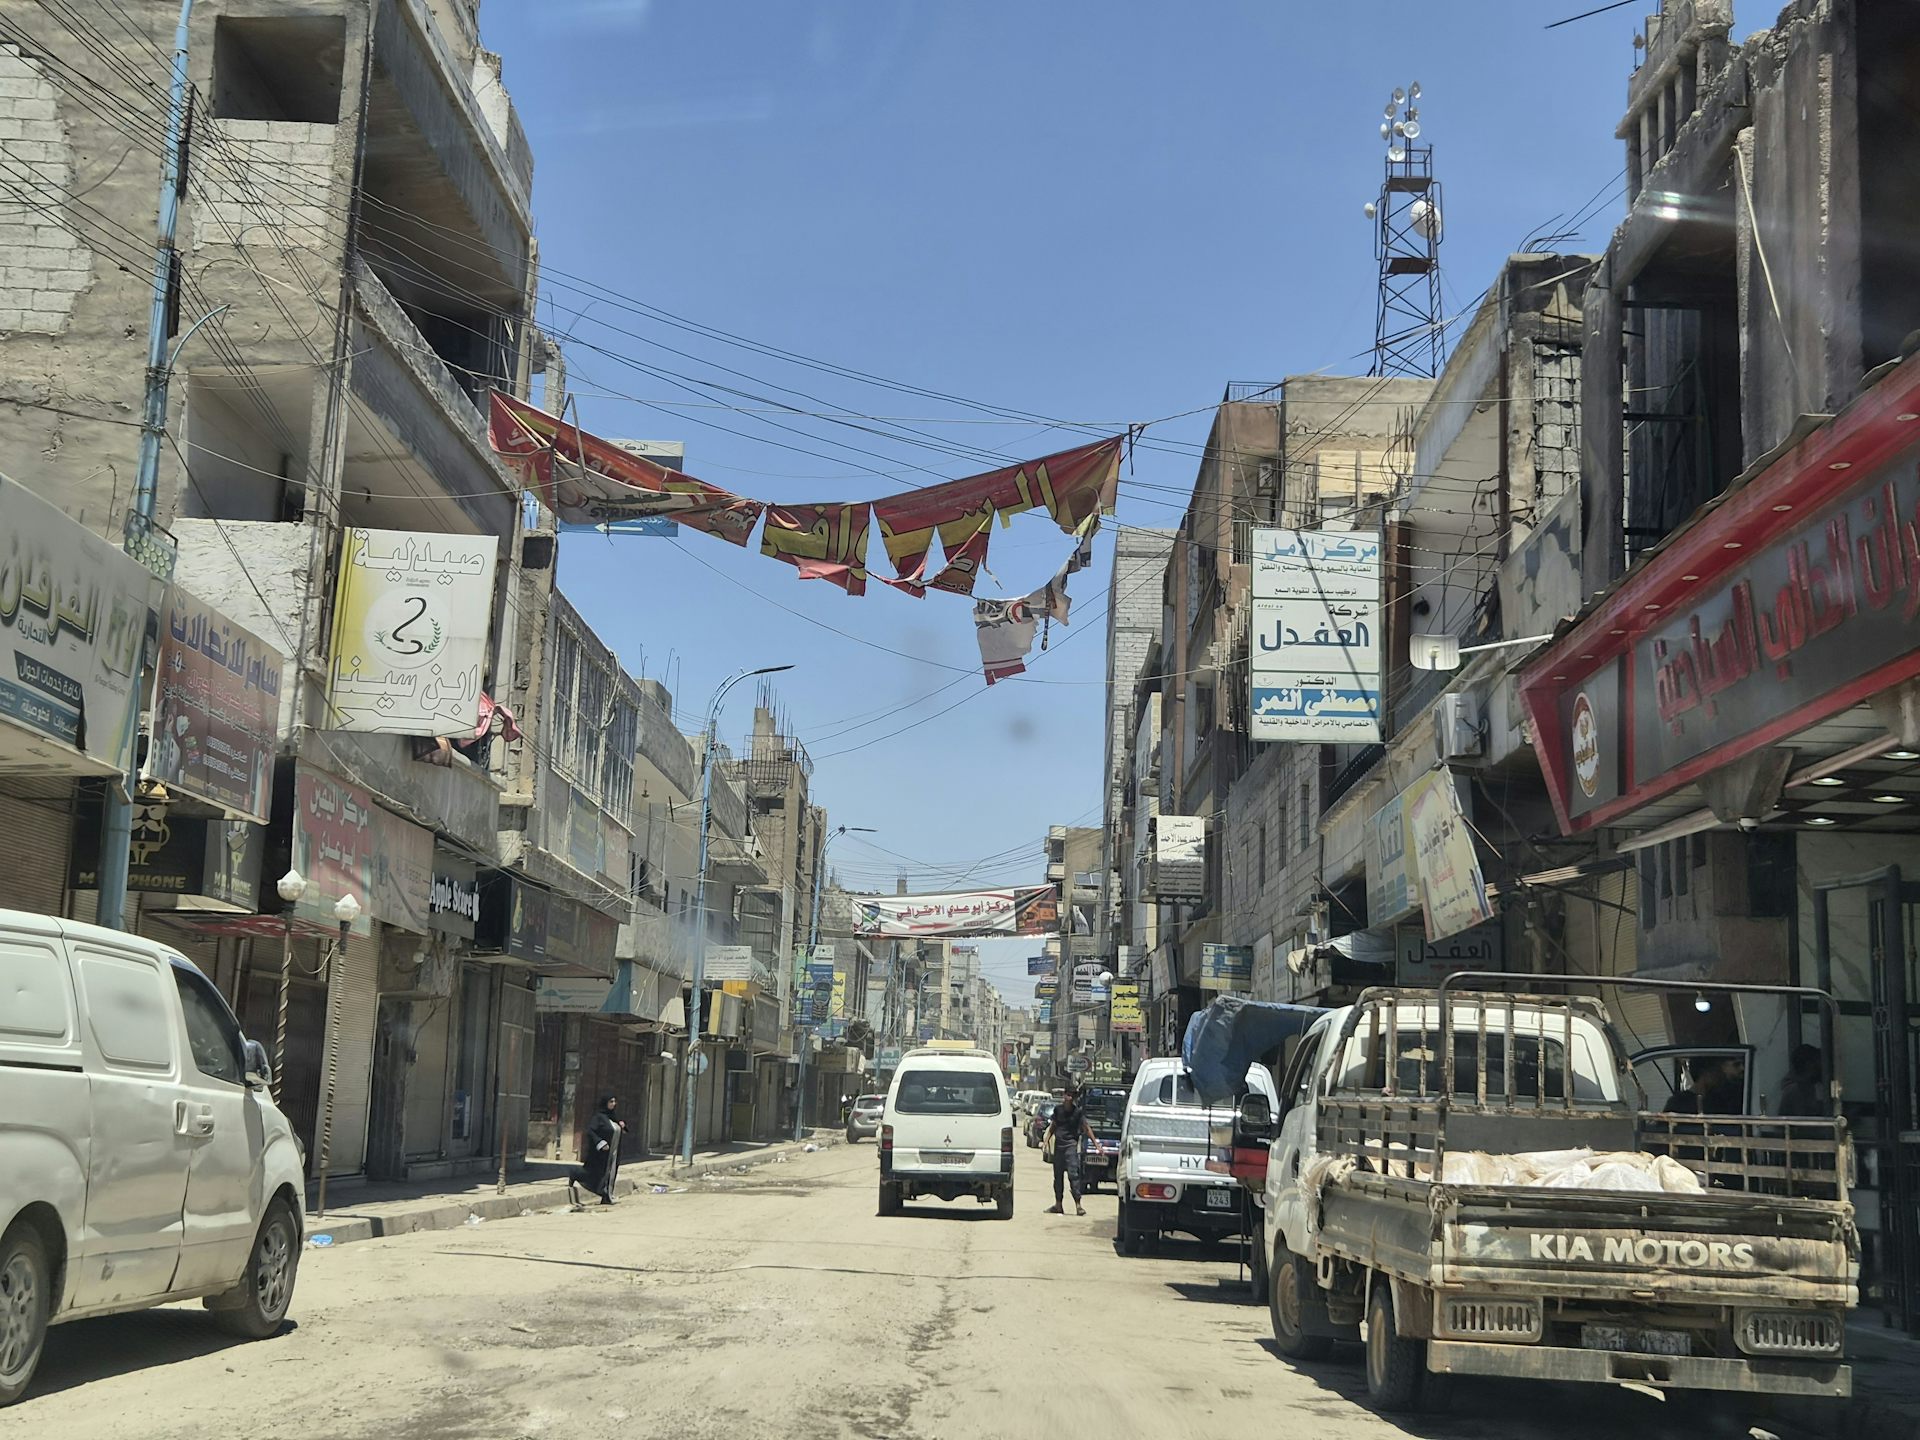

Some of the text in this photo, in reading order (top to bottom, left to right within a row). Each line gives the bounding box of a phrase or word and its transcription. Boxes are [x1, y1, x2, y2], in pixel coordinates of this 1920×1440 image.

[352, 529, 485, 586] صيدلية
[1322, 537, 1377, 563] مركز
[1328, 603, 1369, 619] شركة
[18, 614, 47, 645] التجارية
[1259, 619, 1370, 651] العفدل
[19, 658, 41, 681] الجوال
[40, 668, 62, 692] خدمات
[1294, 675, 1338, 688] الدكتور
[62, 679, 82, 702] لكافة
[332, 655, 478, 716] ابن سينا
[1254, 688, 1377, 717] مصطفى النمر
[339, 788, 368, 834] مركز
[128, 874, 187, 889] PHONE
[429, 871, 473, 917] Apple Store
[895, 903, 946, 921] الاحترافي
[949, 904, 970, 918] عدي
[985, 899, 1012, 914] مركز
[1407, 937, 1492, 965] العفدل
[1529, 1233, 1755, 1269] KIA MOTORS
